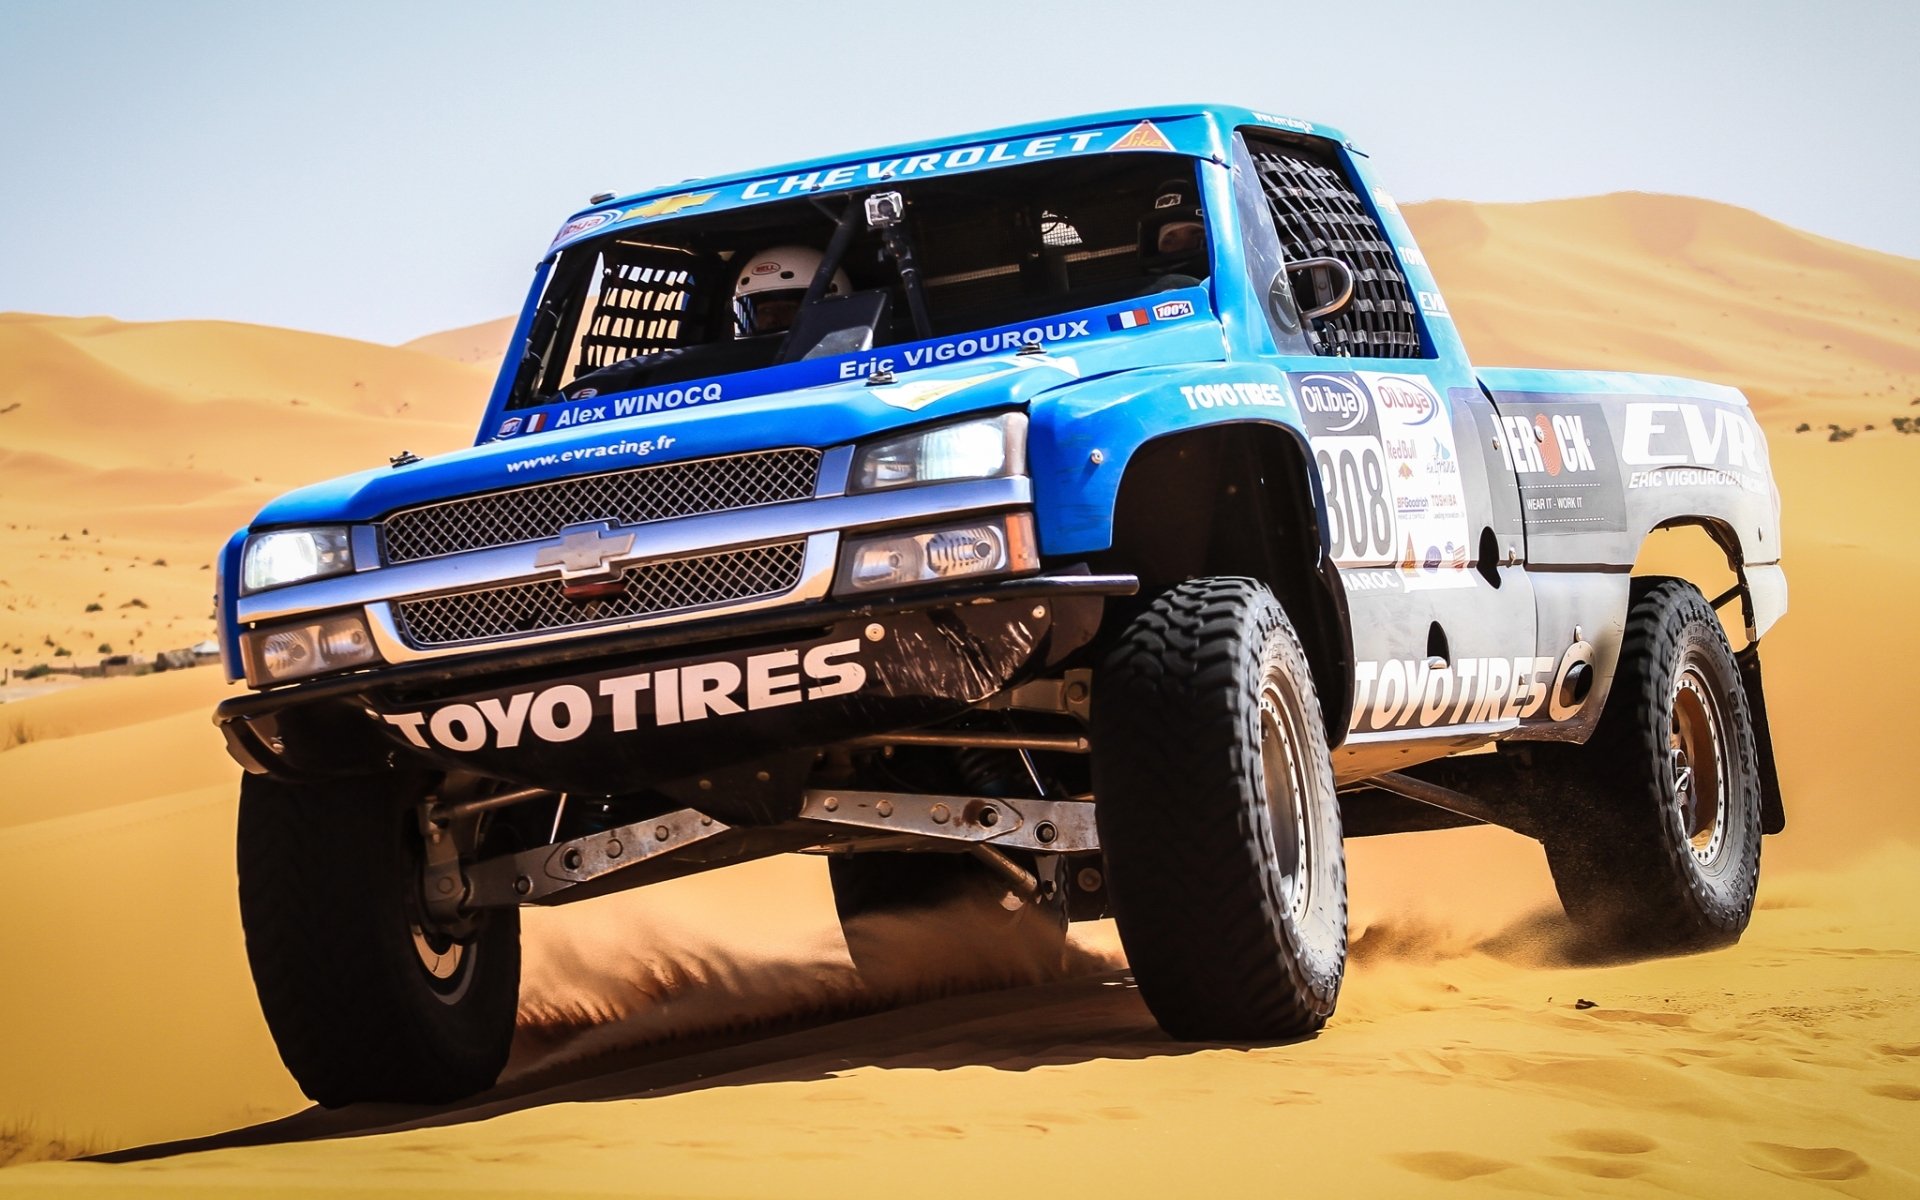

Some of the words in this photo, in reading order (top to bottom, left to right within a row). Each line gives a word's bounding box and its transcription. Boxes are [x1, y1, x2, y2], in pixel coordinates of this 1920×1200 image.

[1119, 131, 1164, 148] Sika
[741, 132, 1103, 200] CHEVROLET
[1157, 303, 1190, 318] 100%
[839, 356, 894, 379] Eric
[904, 319, 1091, 368] VIGOUROUX
[555, 405, 605, 429] Alex
[613, 383, 723, 418] WINOCQ
[1180, 383, 1239, 410] TOYO
[1234, 383, 1286, 408] TIRES
[506, 434, 676, 474] www.evracing.fr
[1386, 439, 1402, 459] Red
[1622, 402, 1763, 474] EVR
[1431, 494, 1457, 507] TOSHIBA
[1628, 472, 1664, 489] ERIC
[1317, 448, 1391, 559] 308
[1527, 498, 1545, 510] WEAR
[1545, 498, 1552, 510] IT
[1557, 497, 1577, 510] WORK
[1577, 496, 1583, 508] IT
[382, 684, 593, 752] TOYO
[599, 638, 867, 733] TIRES
[1349, 658, 1455, 730] TOYO
[1449, 656, 1555, 725] TIRES
